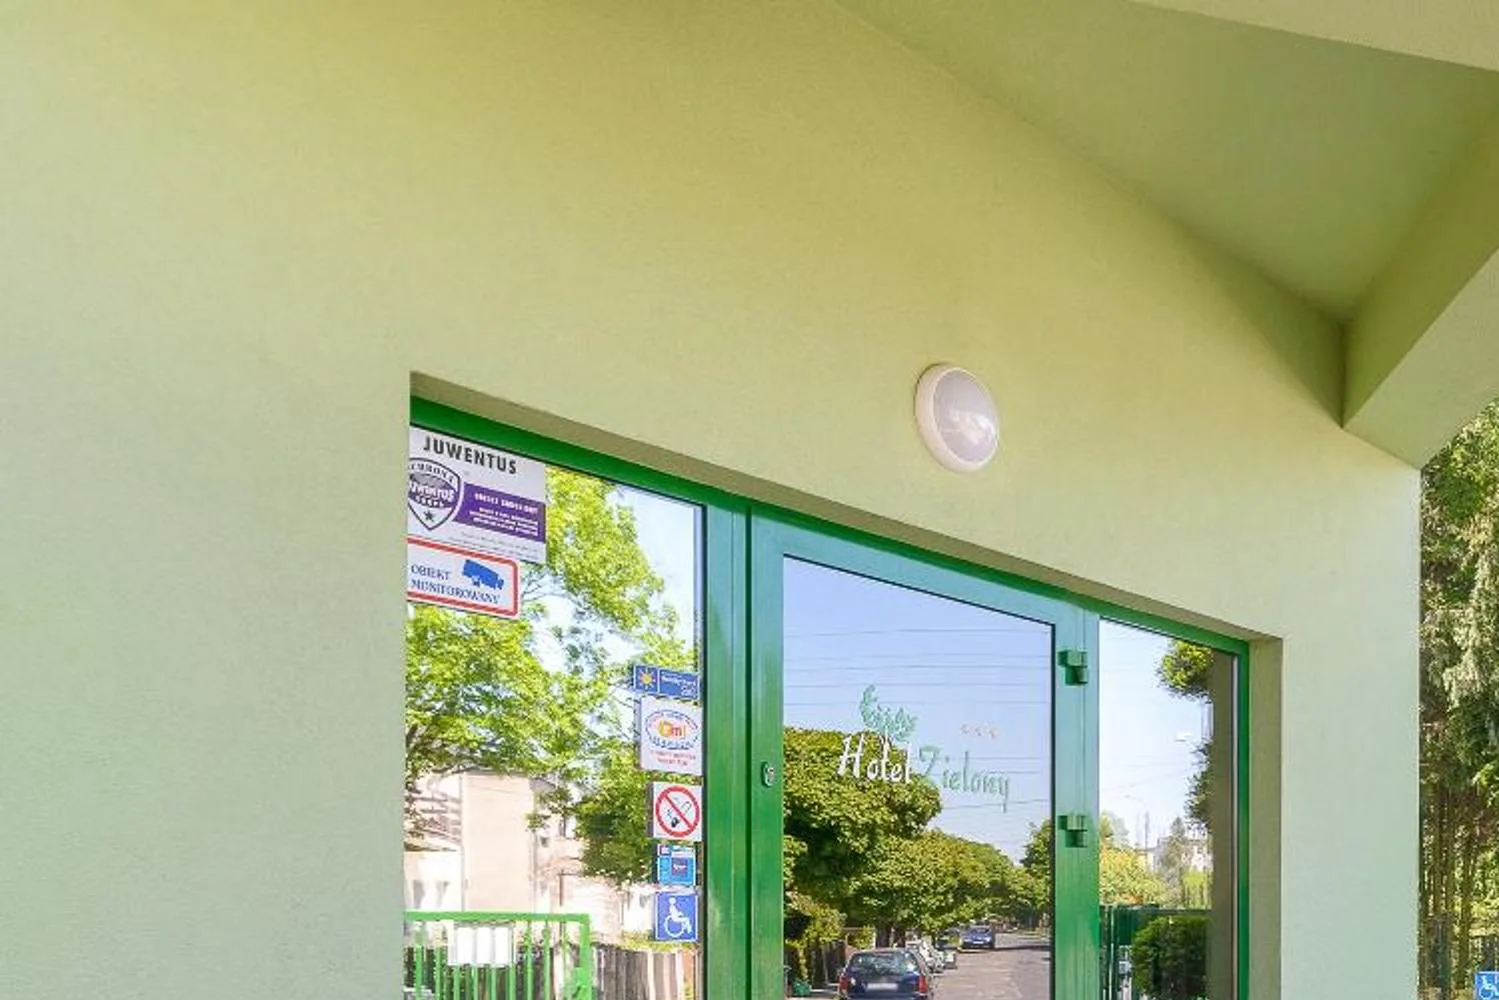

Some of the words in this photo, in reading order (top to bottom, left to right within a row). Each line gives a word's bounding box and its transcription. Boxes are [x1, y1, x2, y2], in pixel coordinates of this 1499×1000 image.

[423, 435, 517, 474] JUWENTUS
[410, 564, 451, 581] OBIEKT
[836, 727, 912, 784] Hotel
[918, 744, 1010, 813] Zielony
